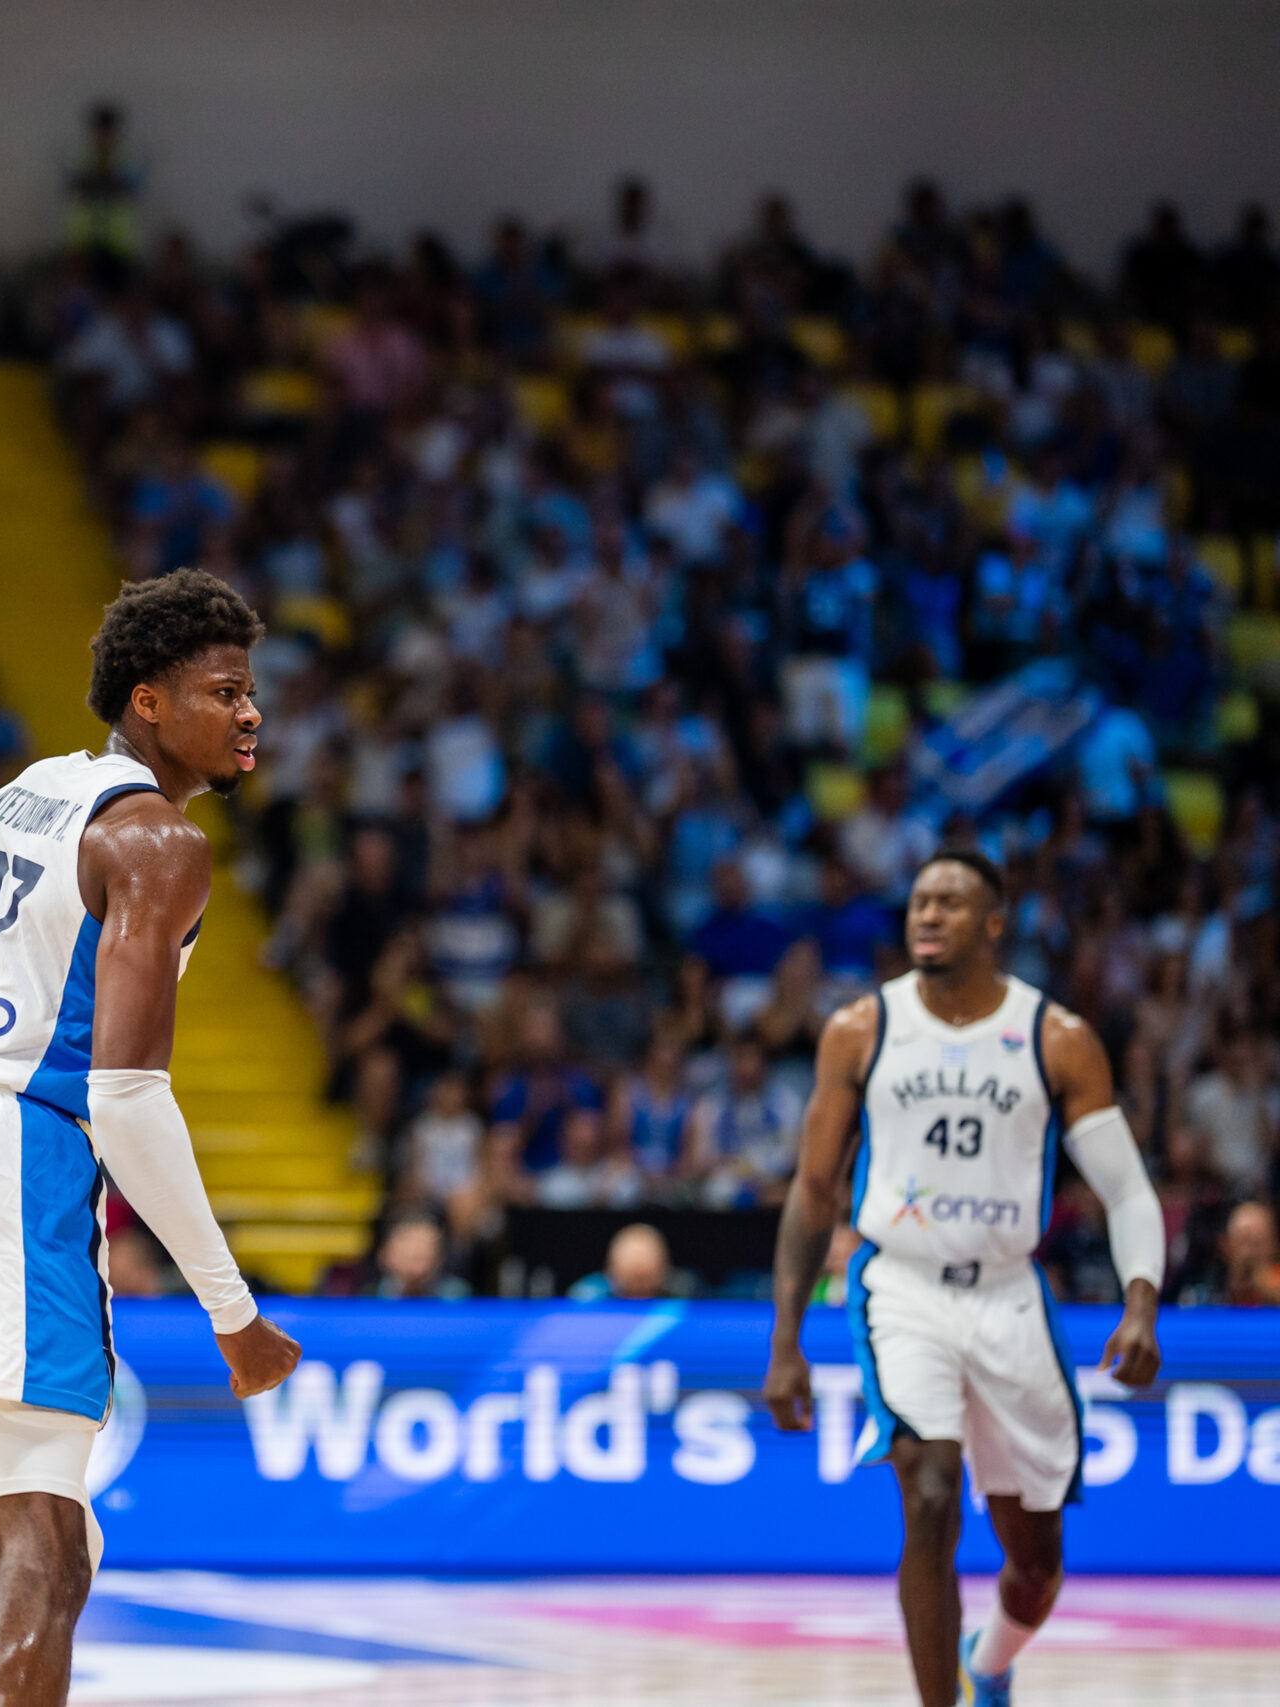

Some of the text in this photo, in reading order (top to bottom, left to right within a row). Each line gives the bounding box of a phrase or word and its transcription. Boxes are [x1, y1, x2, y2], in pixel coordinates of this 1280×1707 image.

[892, 1068, 1023, 1115] HELLAS
[924, 1115, 984, 1159] 43
[242, 1359, 756, 1486] World's
